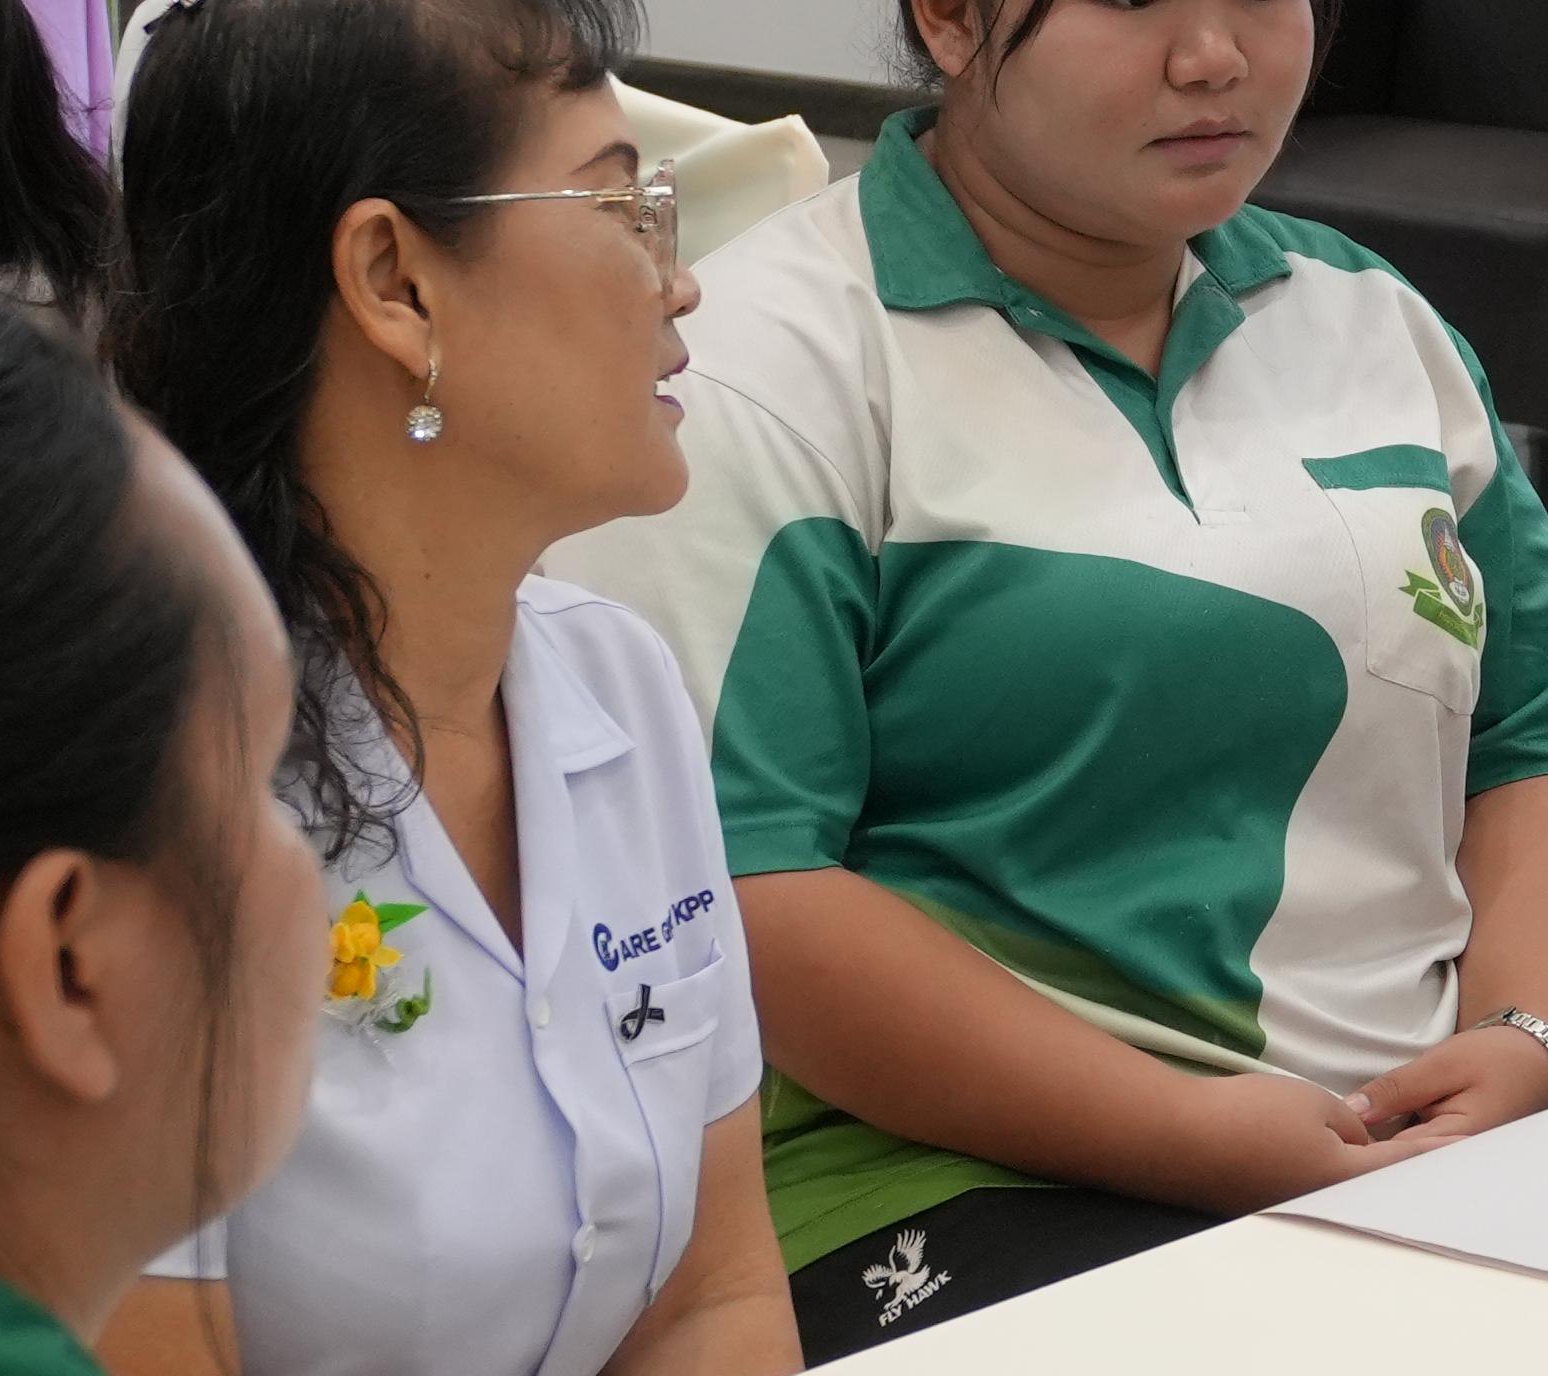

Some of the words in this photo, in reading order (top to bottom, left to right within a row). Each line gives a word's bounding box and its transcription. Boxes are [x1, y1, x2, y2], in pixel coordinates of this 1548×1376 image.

[670, 889, 714, 925] KPP
[878, 1304, 902, 1328] FLY
[906, 1270, 952, 1310] HAWK
